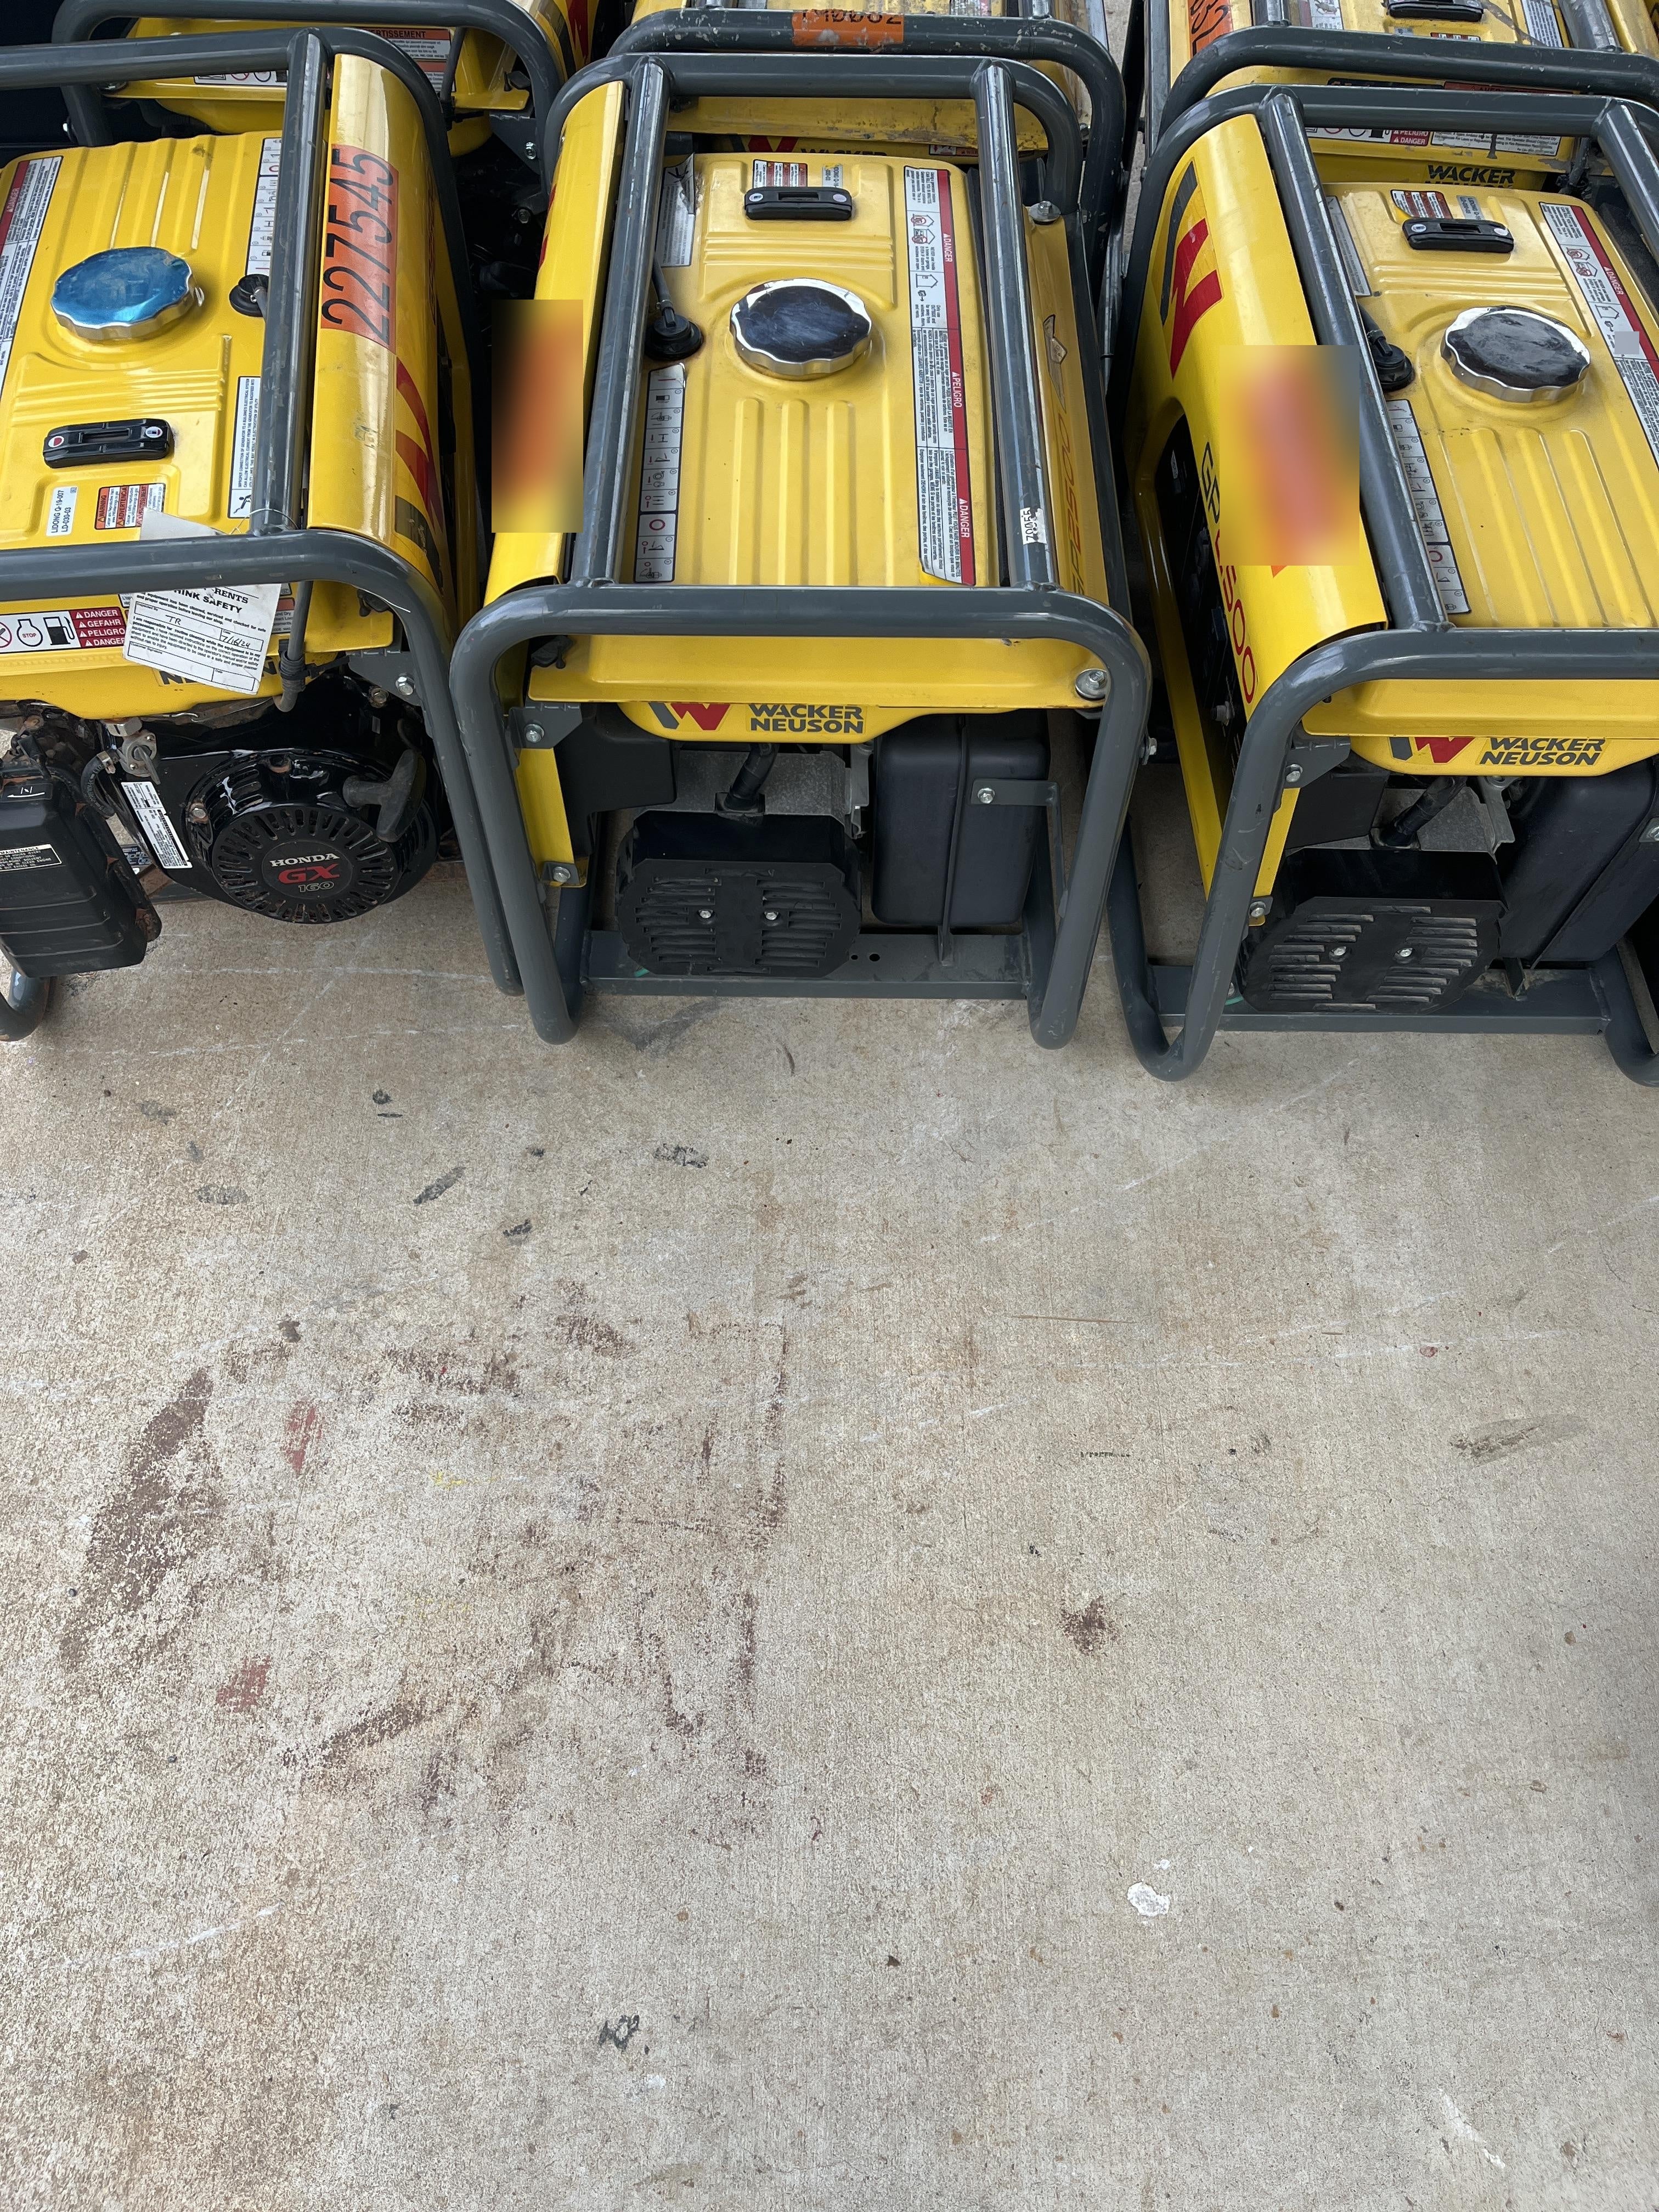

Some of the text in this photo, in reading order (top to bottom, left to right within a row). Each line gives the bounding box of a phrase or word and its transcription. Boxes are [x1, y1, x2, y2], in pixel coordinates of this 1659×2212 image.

[1400, 137, 1425, 145] DANGER
[1427, 164, 1515, 184] WACKER
[321, 148, 393, 346] 227545
[943, 238, 952, 262] DANGER
[1605, 270, 1624, 295] DANGER
[951, 377, 962, 408] PELIGRO
[98, 494, 107, 517] WARNING
[117, 487, 128, 520] ADVERTENCIA
[50, 512, 60, 533] LIDONG
[60, 507, 71, 532] LD-030-03
[959, 505, 969, 538] DANGER
[1202, 442, 1255, 704] GP500
[173, 589, 242, 614] HINK SAFETY
[83, 609, 119, 618] DANGER
[87, 618, 121, 627] GEFAHR
[163, 614, 182, 625] TR
[87, 628, 125, 636] PELIGRO
[219, 633, 251, 649] 7/16/24
[748, 703, 863, 720] WACKER
[751, 718, 864, 734] NEUSON
[1490, 737, 1606, 752] WACKER
[1479, 751, 1599, 765] NEUSON
[0, 846, 39, 854] MAINTENANCE
[269, 853, 340, 867] HONDA
[278, 862, 340, 884] GX
[298, 881, 334, 893] 160
